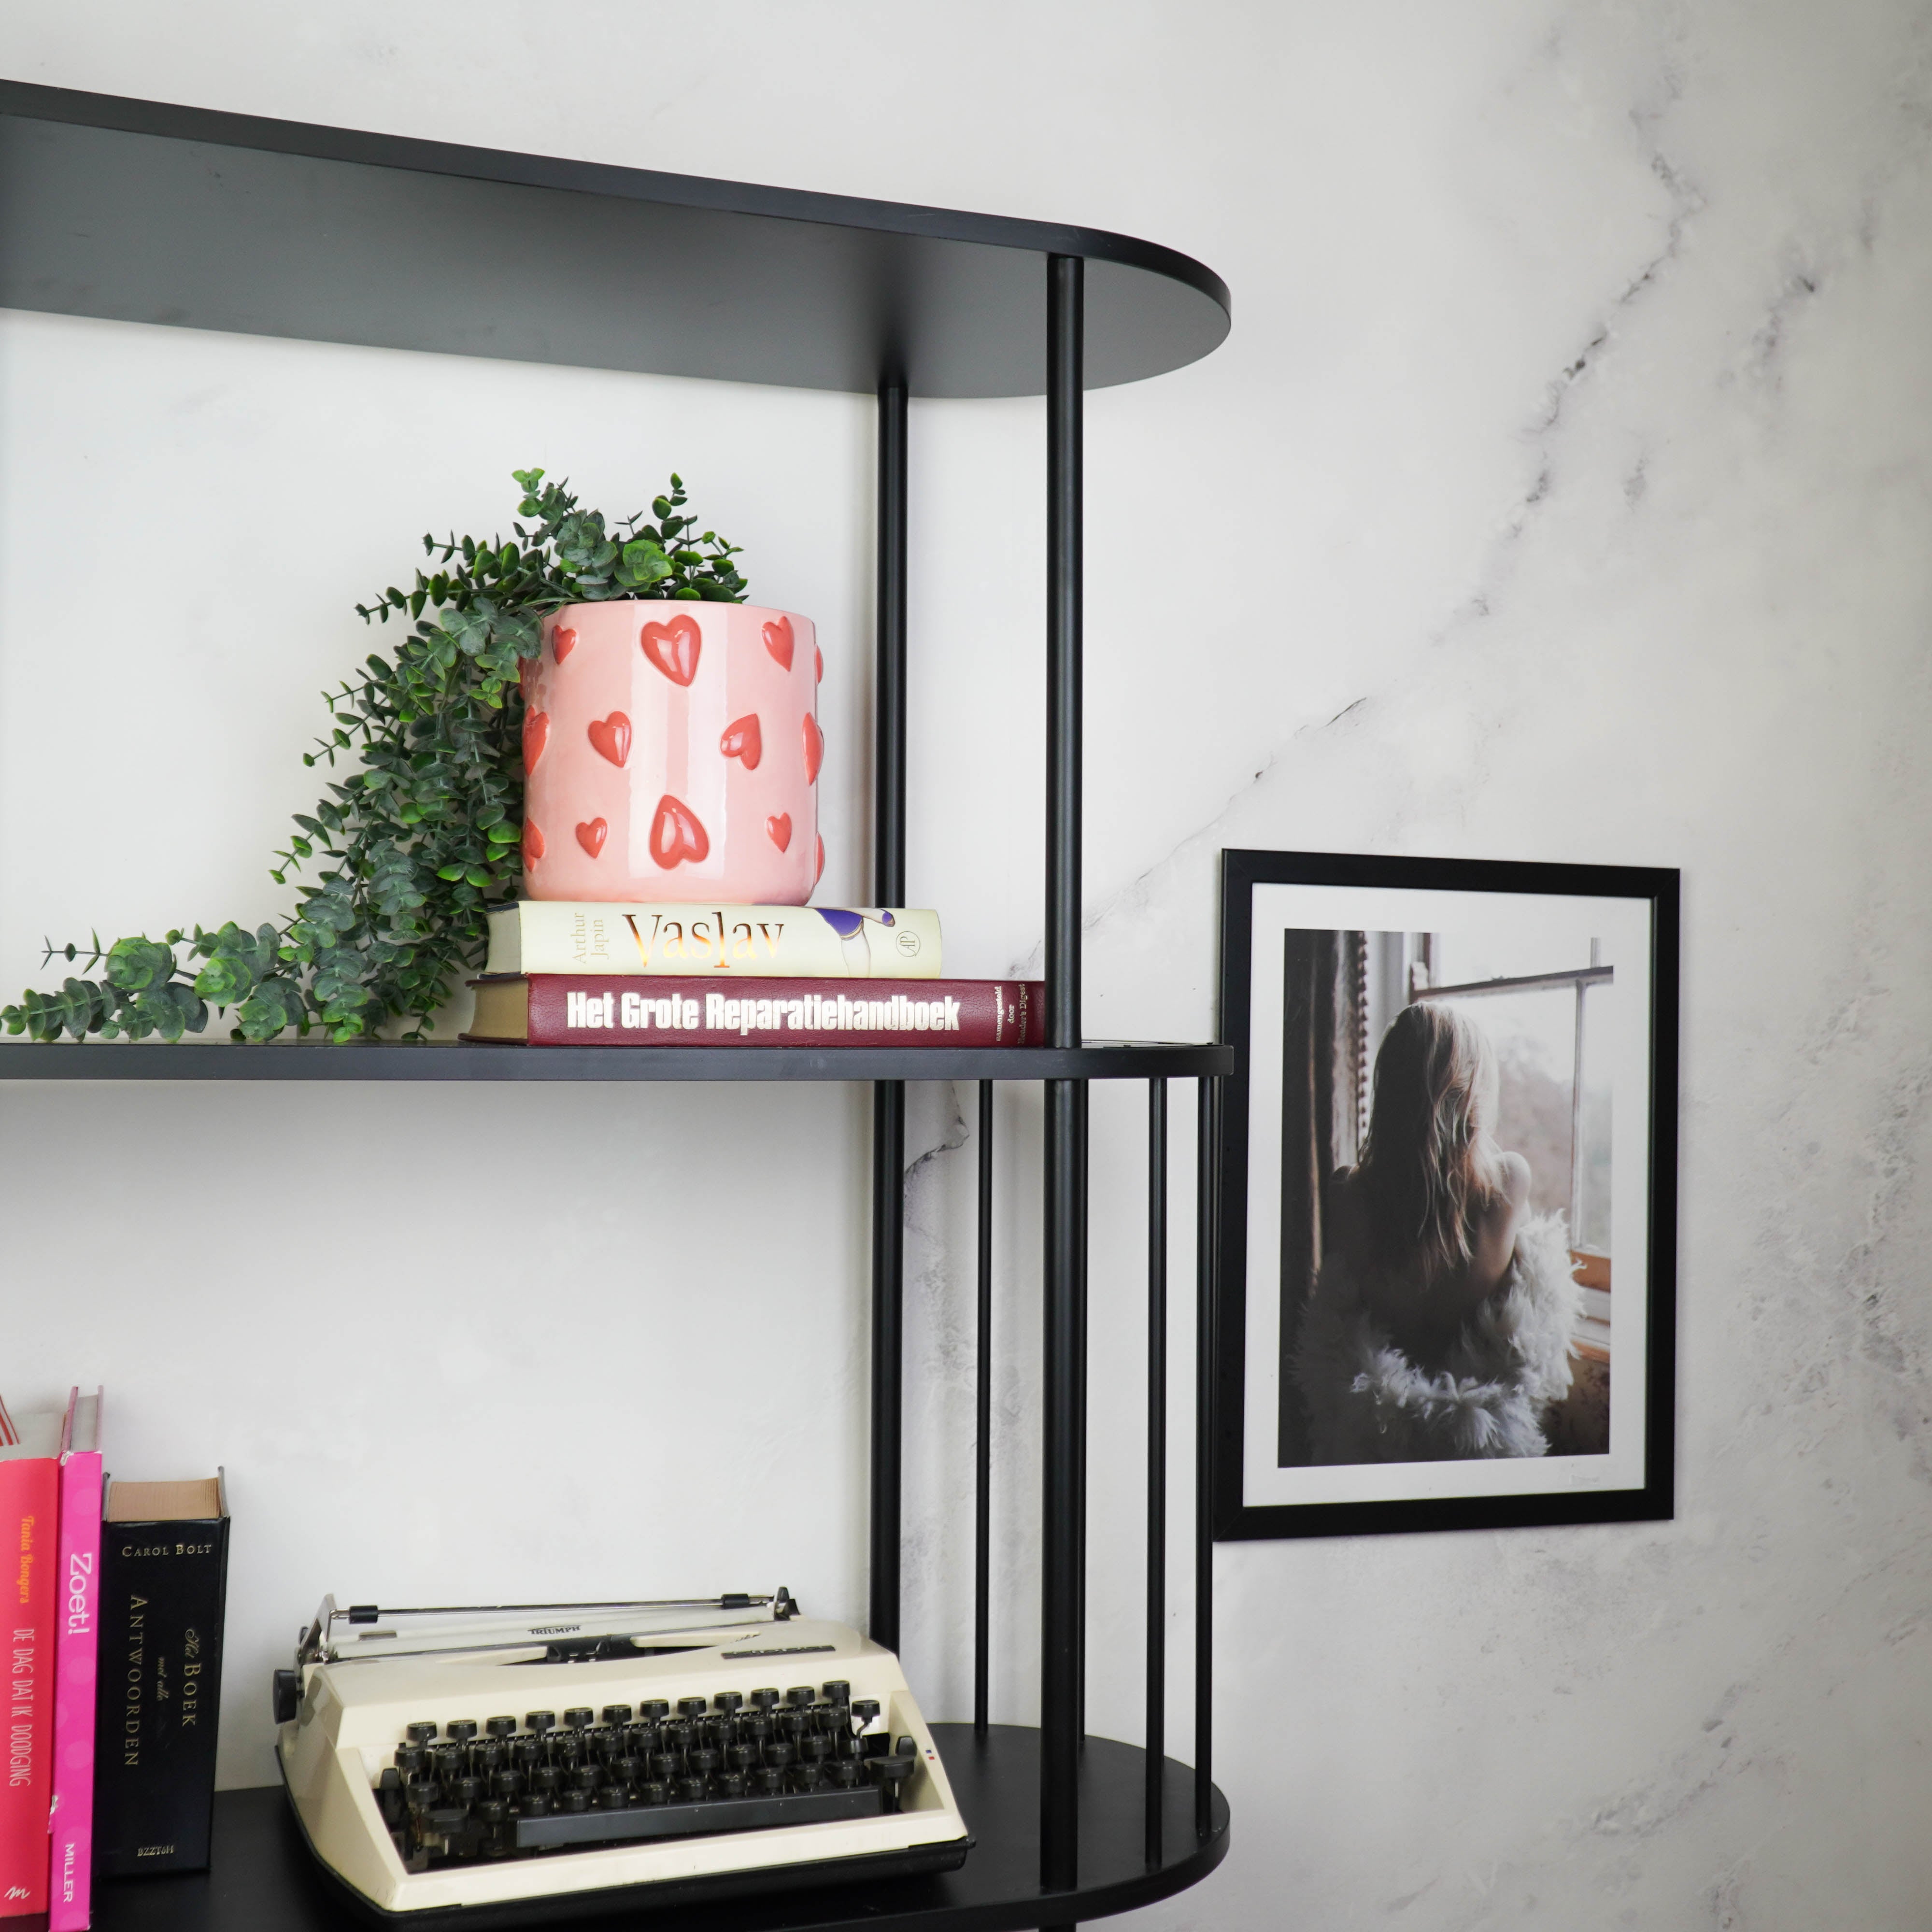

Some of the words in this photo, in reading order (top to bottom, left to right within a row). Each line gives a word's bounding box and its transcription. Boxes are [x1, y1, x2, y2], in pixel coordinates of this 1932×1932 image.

[570, 912, 586, 964] Arthur
[590, 919, 610, 960] Japin
[622, 911, 784, 968] Vaslav
[567, 992, 615, 1029] Het
[621, 992, 699, 1029] Grote
[706, 993, 961, 1036] Reparatiehandboek
[1018, 983, 1028, 1009] Digest
[21, 1515, 34, 1552] Tania
[122, 1546, 169, 1557] CAROL
[176, 1544, 212, 1555] BOLT
[16, 1554, 33, 1604] Bongers
[68, 1553, 92, 1635] Zoet!
[13, 1628, 34, 1642] DE
[527, 1625, 581, 1635] TRIUMPH
[12, 1648, 34, 1674] DAG
[124, 1595, 148, 1766] ANTWOORDEN
[12, 1679, 33, 1701] DAT
[182, 1662, 201, 1727] BOEK
[12, 1706, 32, 1718] IK
[9, 1725, 32, 1787] DOODGING
[63, 1843, 75, 1903] MILLER
